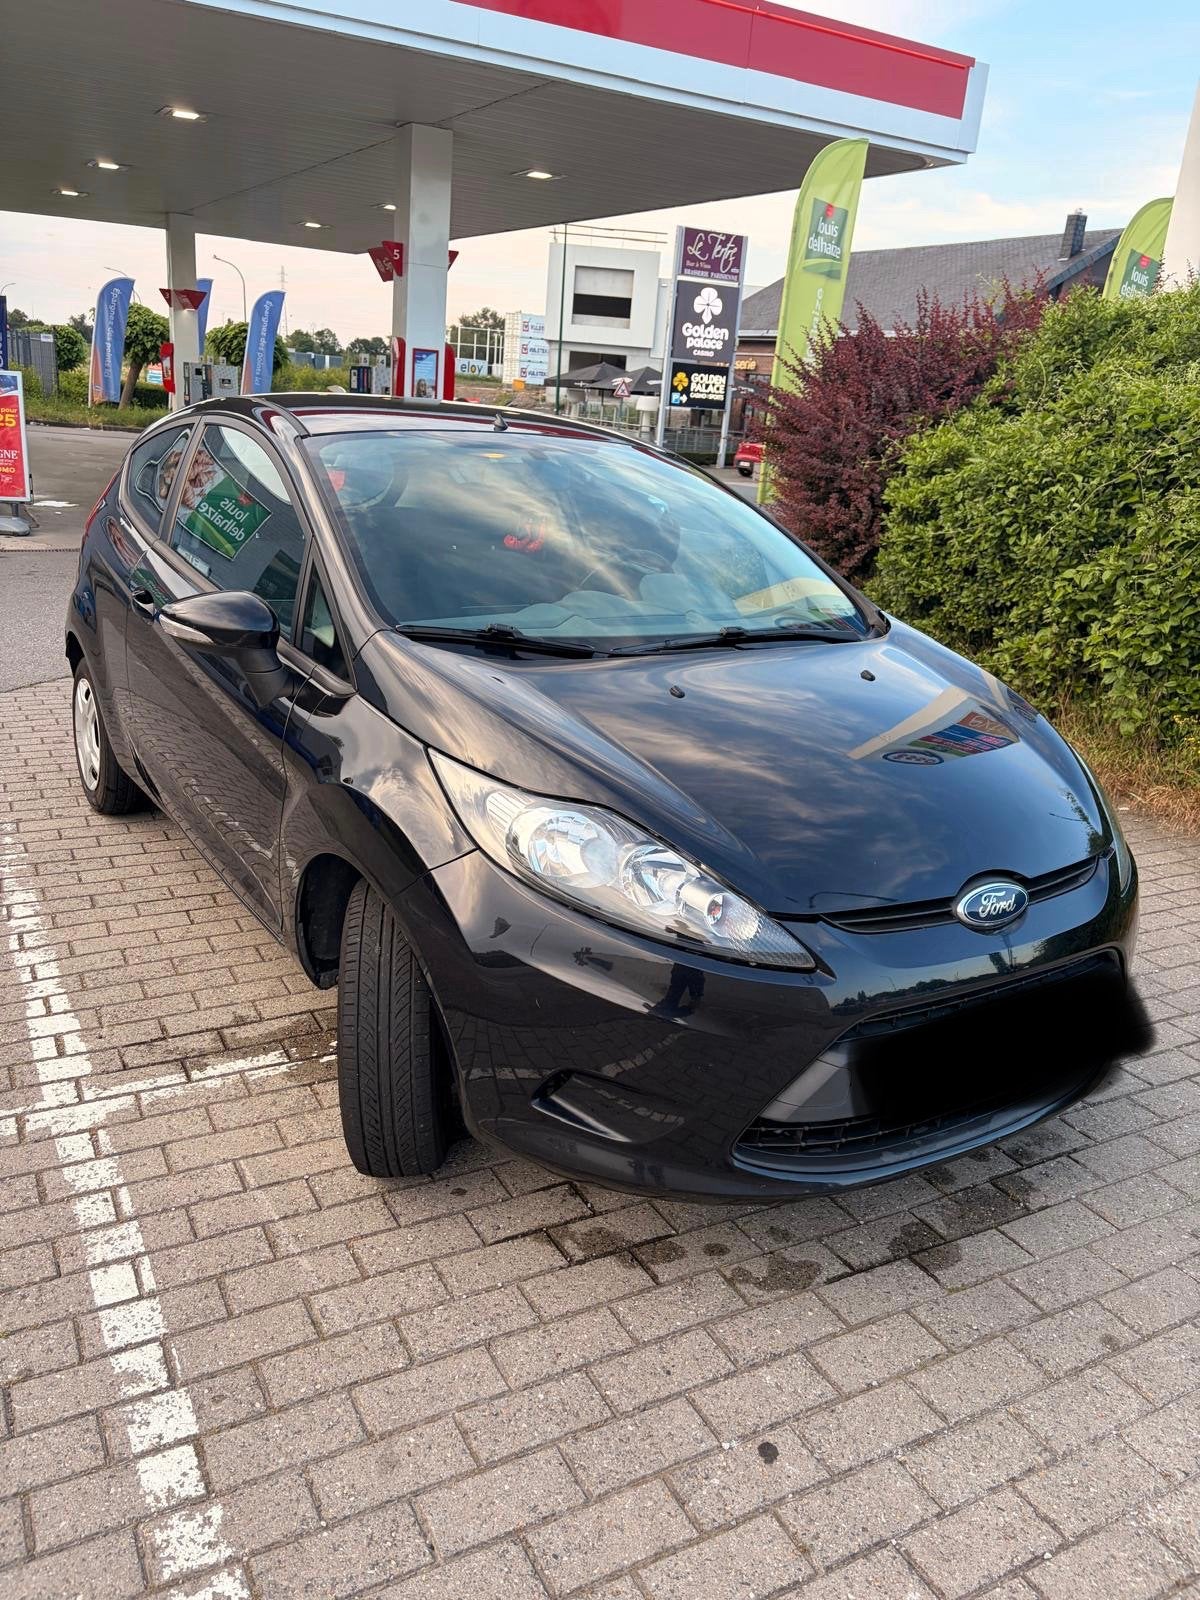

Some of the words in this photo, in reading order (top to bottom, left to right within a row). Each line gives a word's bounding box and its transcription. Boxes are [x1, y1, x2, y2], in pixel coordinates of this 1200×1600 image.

[817, 216, 838, 237] louis
[393, 249, 400, 259] 5
[687, 233, 709, 260] Le
[808, 235, 841, 258] delhaize
[1131, 266, 1149, 287] louis
[261, 300, 273, 337] Épargnez
[682, 322, 729, 340] Golden
[686, 337, 723, 350] palace
[460, 361, 484, 375] eloy
[690, 382, 726, 394] PALACE
[691, 373, 726, 385] GOLDEN
[979, 891, 1017, 917] Ford
